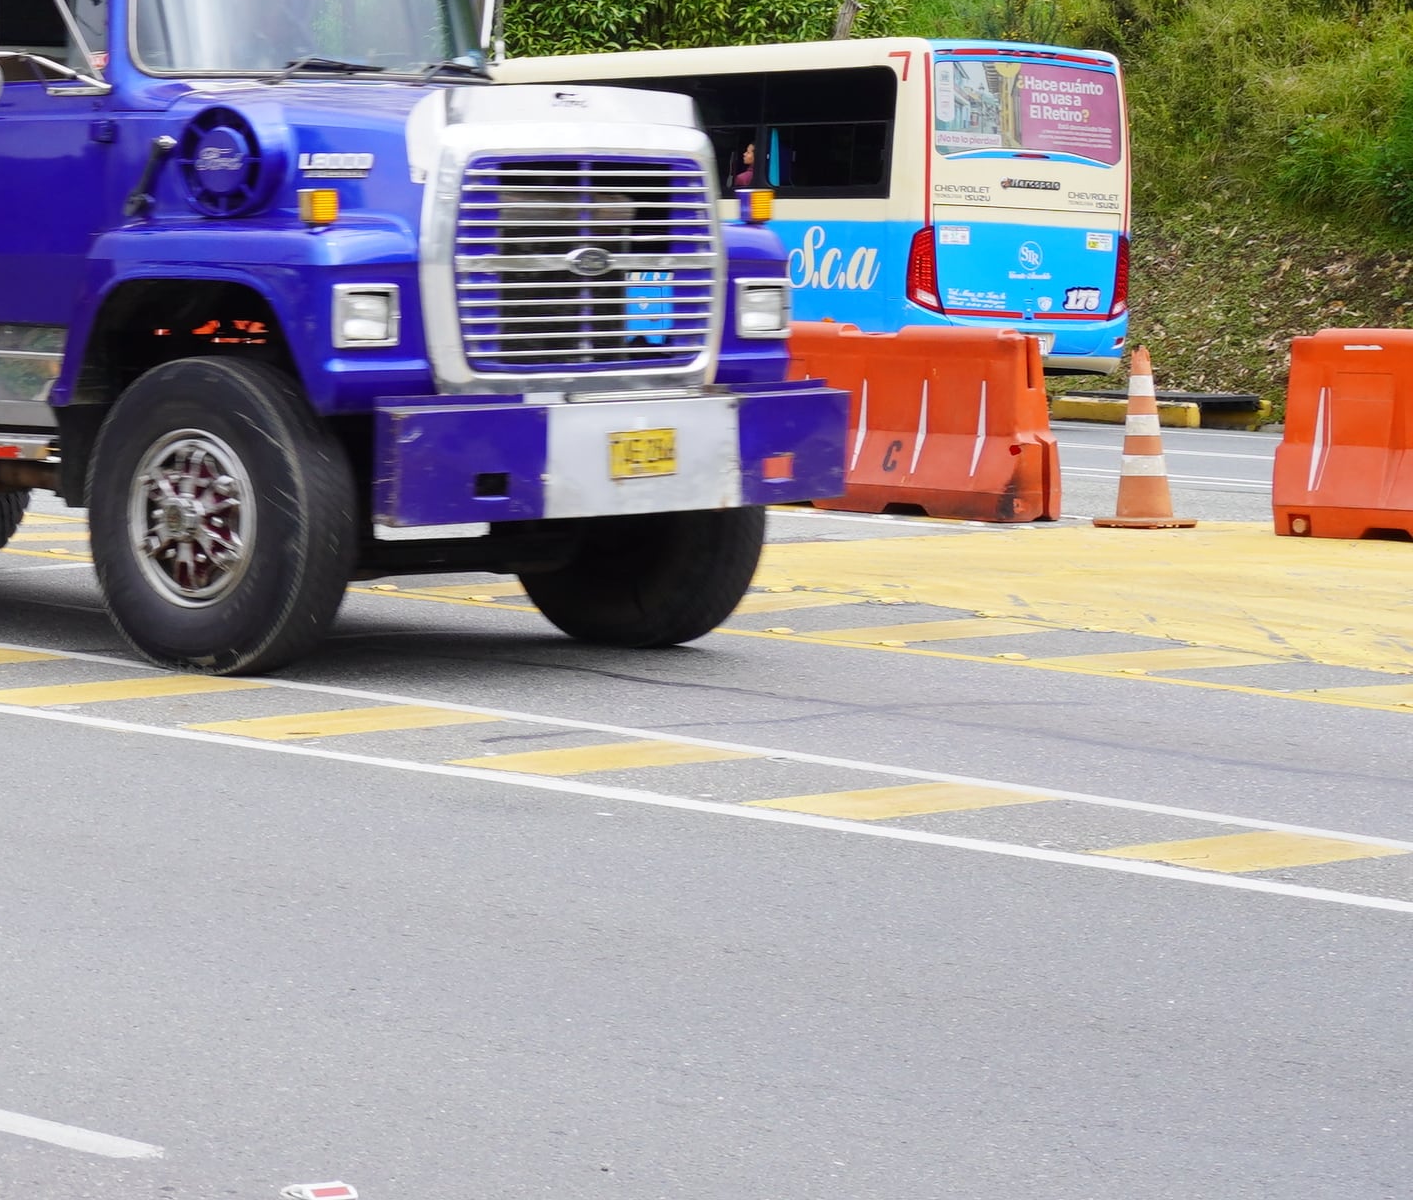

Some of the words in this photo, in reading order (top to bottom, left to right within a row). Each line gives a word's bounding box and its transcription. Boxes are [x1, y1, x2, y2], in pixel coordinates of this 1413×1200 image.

[1016, 75, 1058, 91] ¿Hace
[1059, 78, 1104, 95] cuánto
[1031, 92, 1049, 104] no
[1050, 93, 1073, 106] vas
[1074, 95, 1082, 106] a
[1029, 105, 1041, 119] El
[1043, 106, 1090, 123] Retiro?
[934, 184, 990, 194] CHEVROLET
[965, 194, 991, 202] ISUZU
[1068, 191, 1119, 201] CHEVROLET
[1095, 202, 1119, 210] ISUZU
